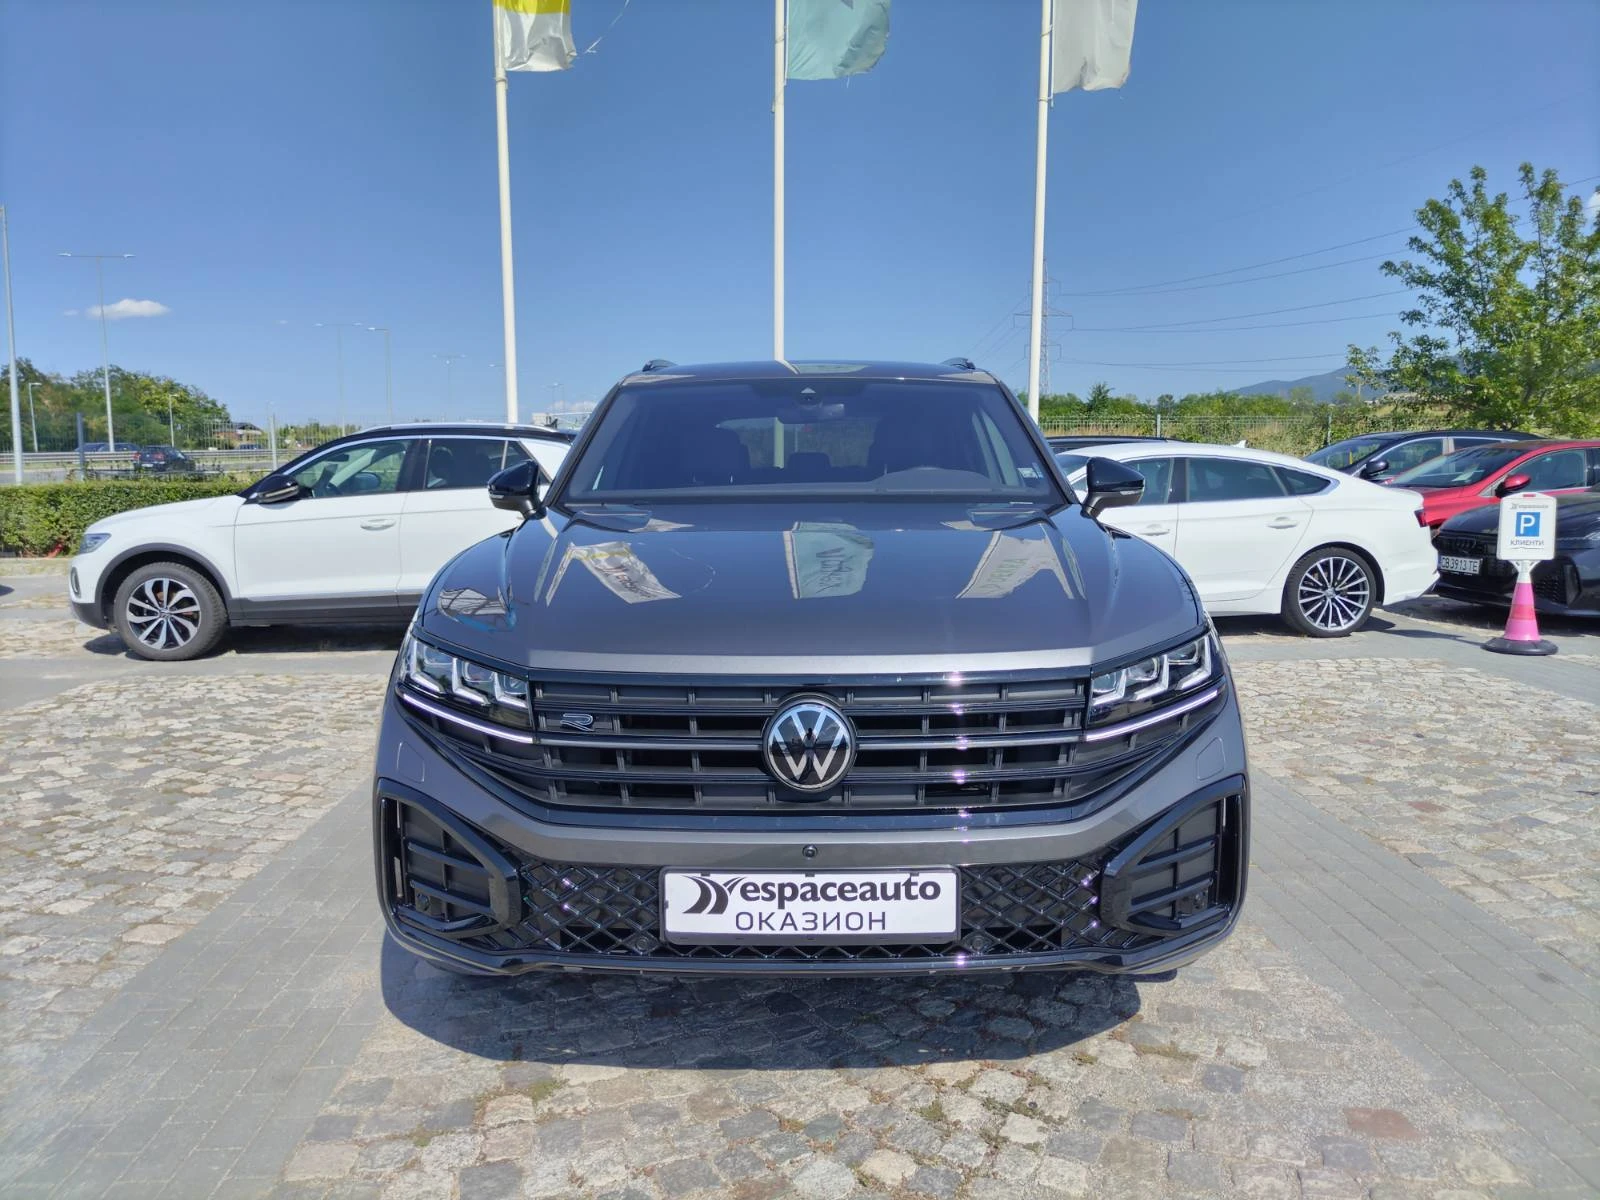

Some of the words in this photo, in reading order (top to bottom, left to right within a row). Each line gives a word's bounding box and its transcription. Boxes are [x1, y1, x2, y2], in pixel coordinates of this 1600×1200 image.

[1519, 514, 1536, 535] P
[739, 875, 941, 909] espaceauto
[735, 911, 886, 931] ОКАЗИОН
